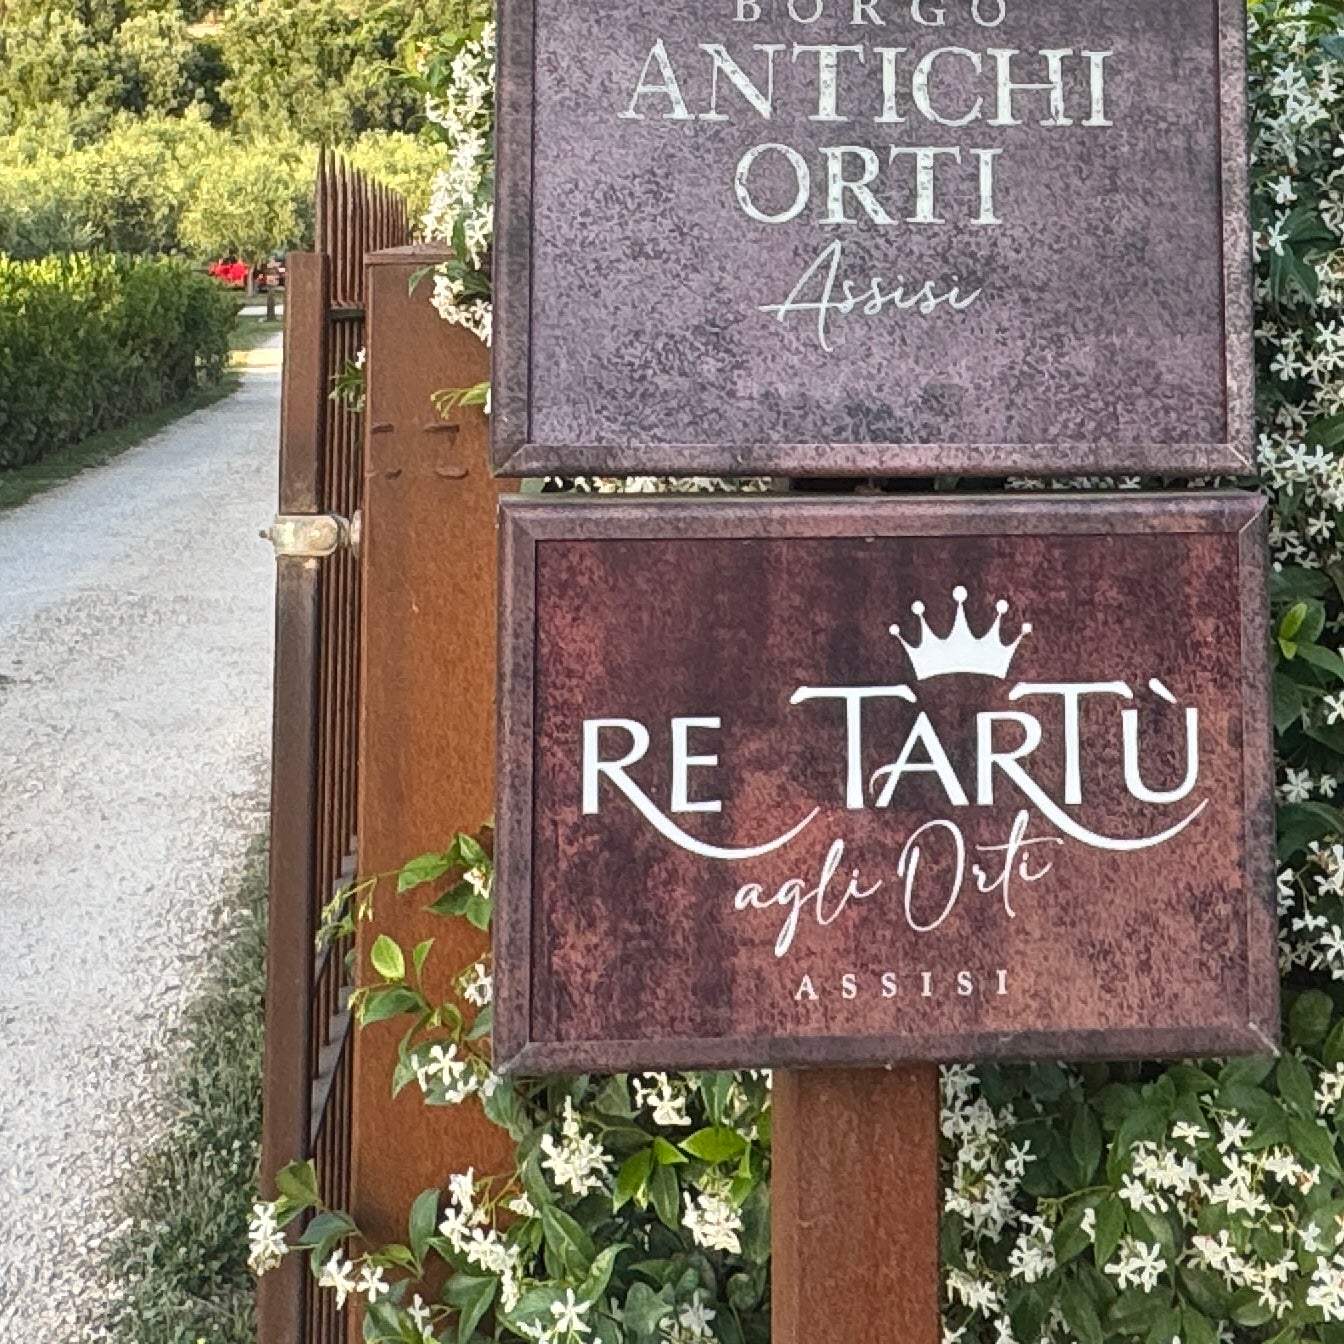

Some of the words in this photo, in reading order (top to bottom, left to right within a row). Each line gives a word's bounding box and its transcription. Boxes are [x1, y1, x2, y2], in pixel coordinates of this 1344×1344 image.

[617, 38, 1113, 127] ANTICHI
[734, 143, 1003, 226] ORTI
[759, 239, 982, 352] Assisi
[581, 717, 820, 859] RE
[789, 677, 1210, 850] TARTÙ
[734, 838, 882, 957] agli
[897, 809, 1064, 933] Orti
[794, 969, 1009, 1001] ASSISI
